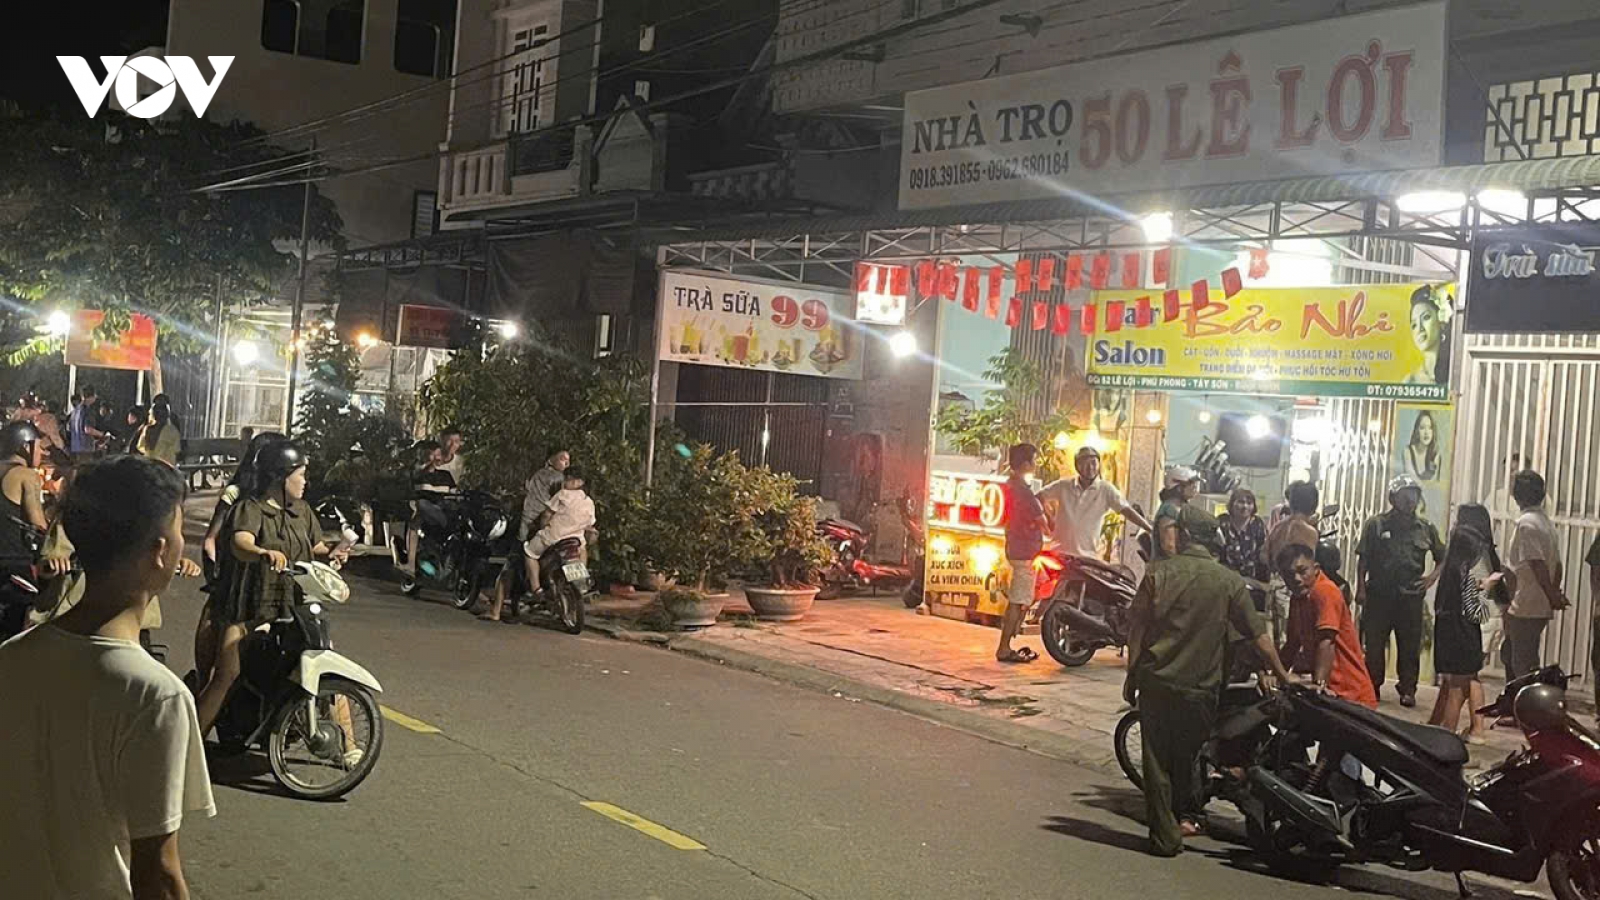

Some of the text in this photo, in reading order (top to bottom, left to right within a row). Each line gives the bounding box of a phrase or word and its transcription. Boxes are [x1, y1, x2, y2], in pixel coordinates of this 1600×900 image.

[911, 39, 1416, 171] NHÀ TRỌ 50 LÊ LỢI
[674, 286, 830, 331] TRÀ SỮA 99
[1180, 291, 1394, 339] Bảo Nhi
[1094, 340, 1165, 365] Salon
[1385, 385, 1446, 398] 0793654791
